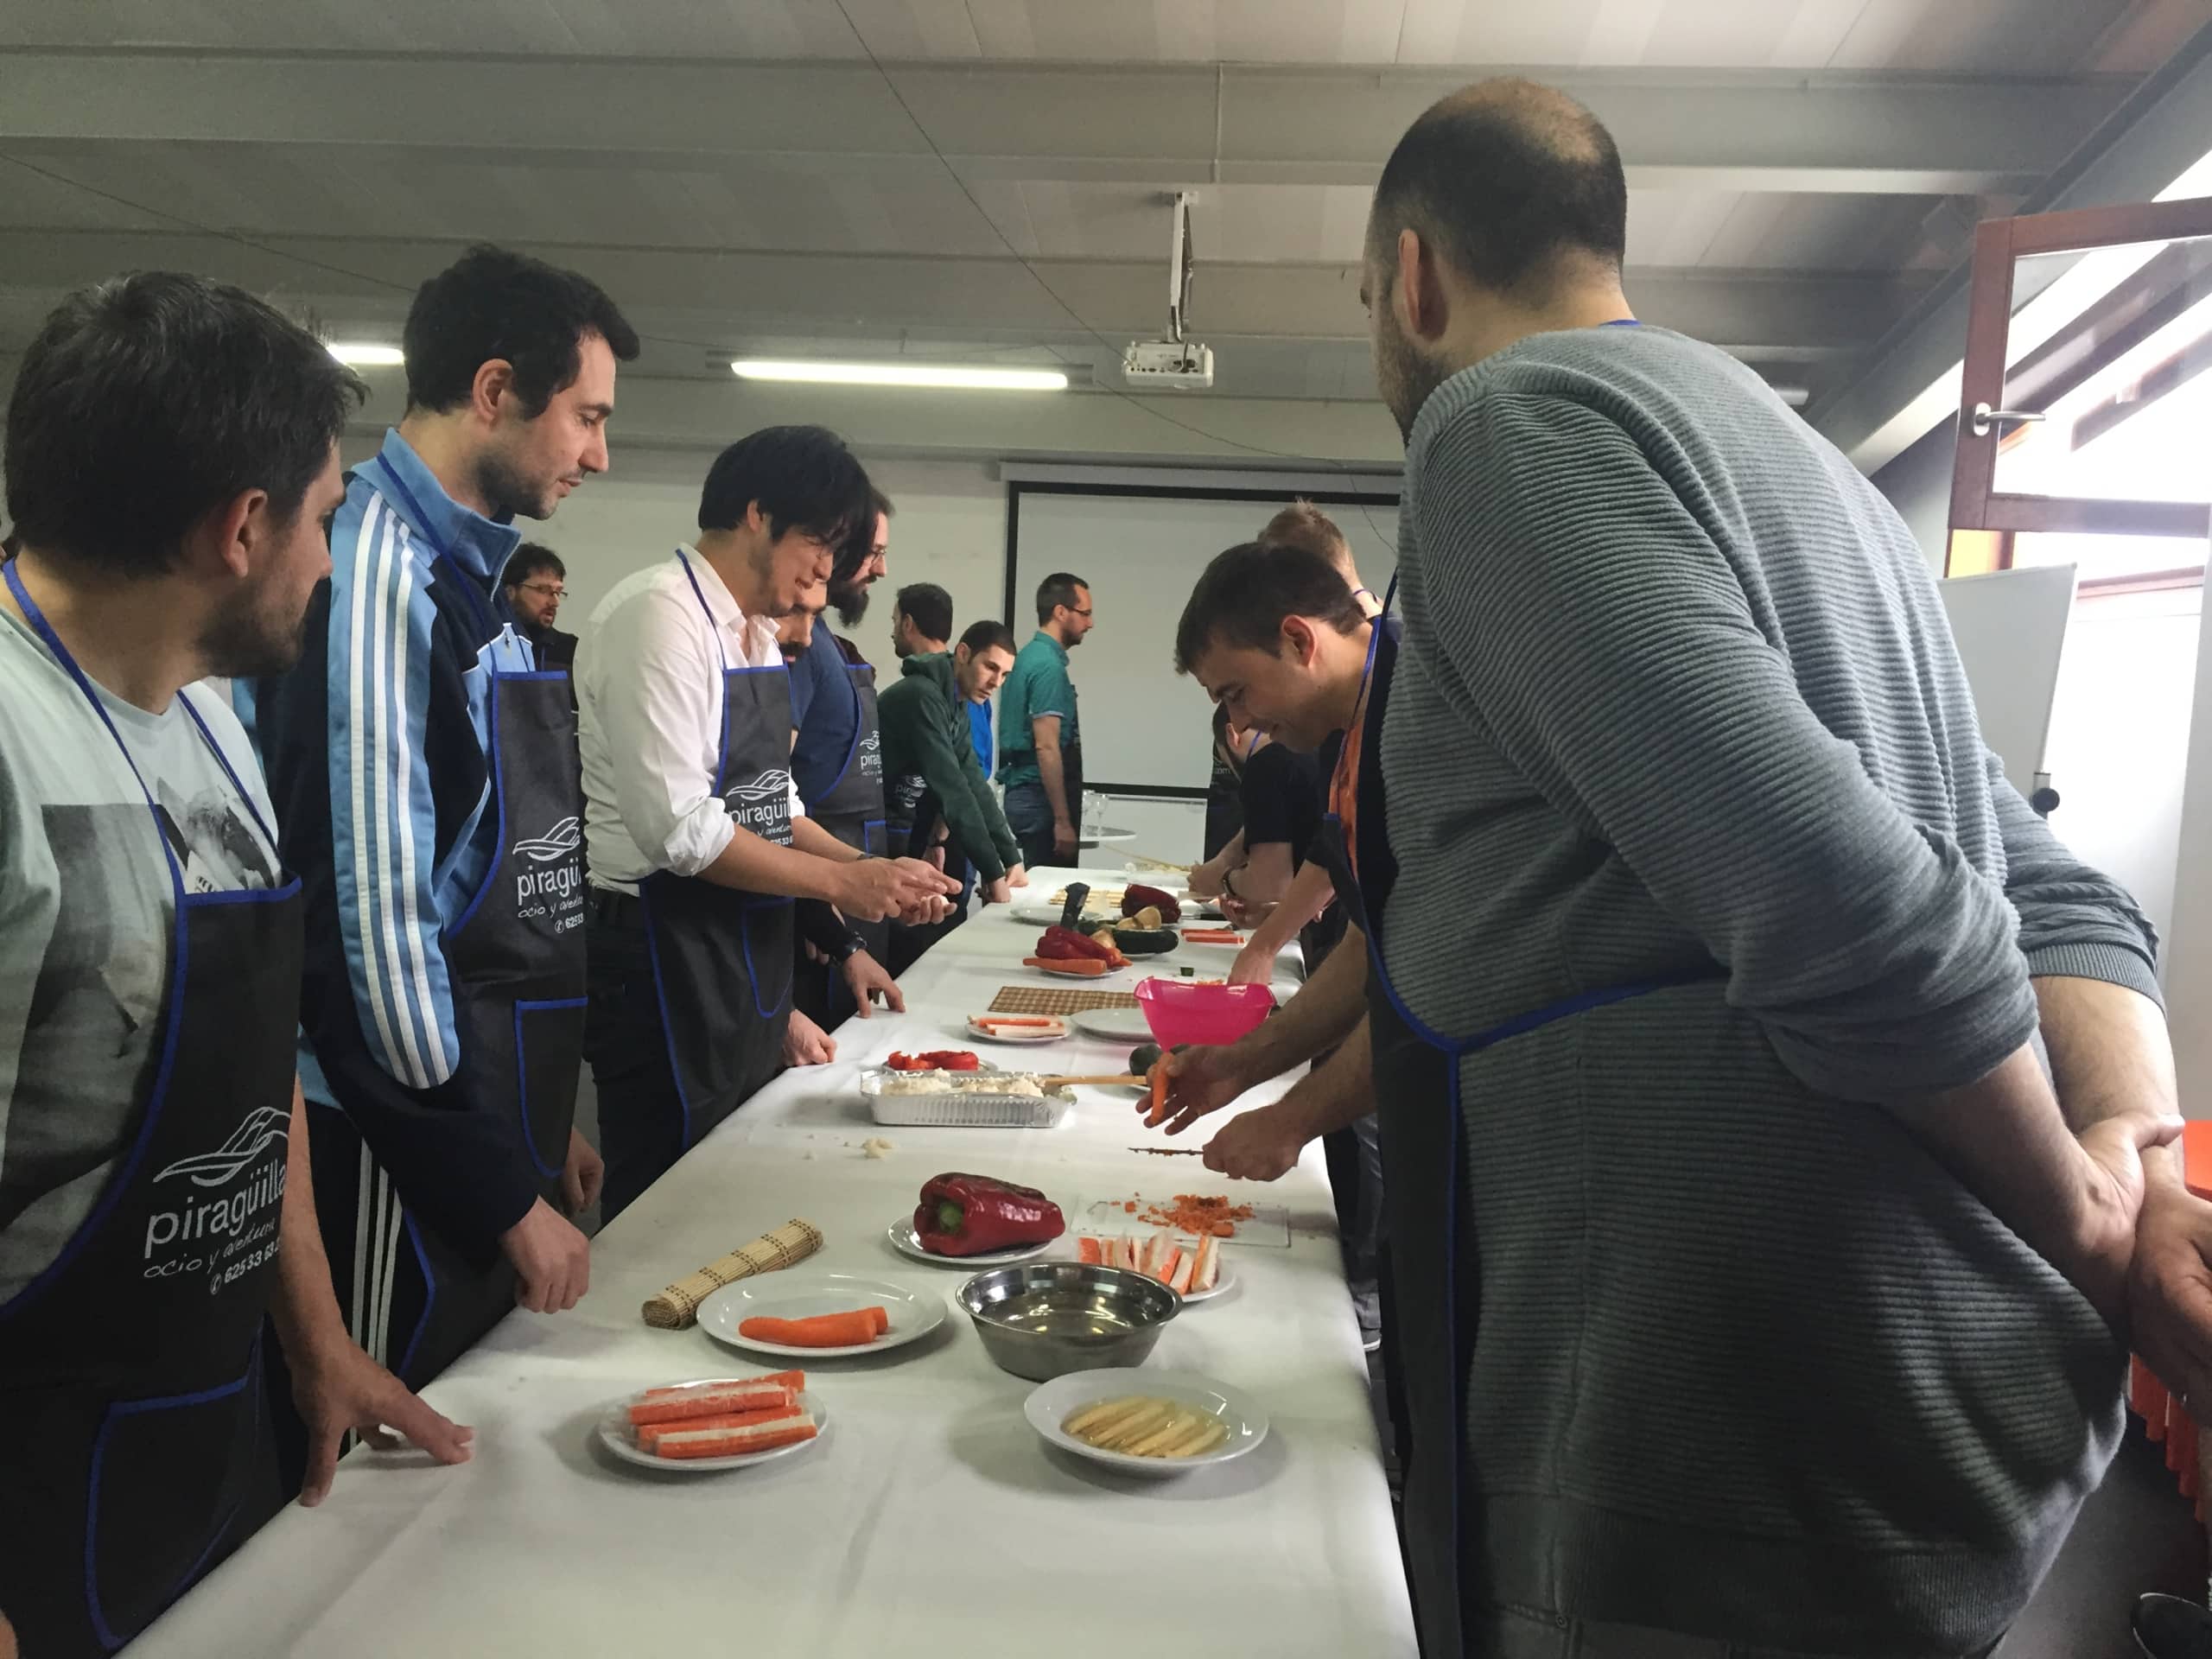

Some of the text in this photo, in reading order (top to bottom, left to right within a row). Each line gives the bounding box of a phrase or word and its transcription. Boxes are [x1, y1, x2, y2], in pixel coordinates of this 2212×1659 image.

[518, 902, 545, 918] ocio
[550, 902, 557, 919] y
[143, 1253, 202, 1278] ocio
[207, 1249, 220, 1274] y
